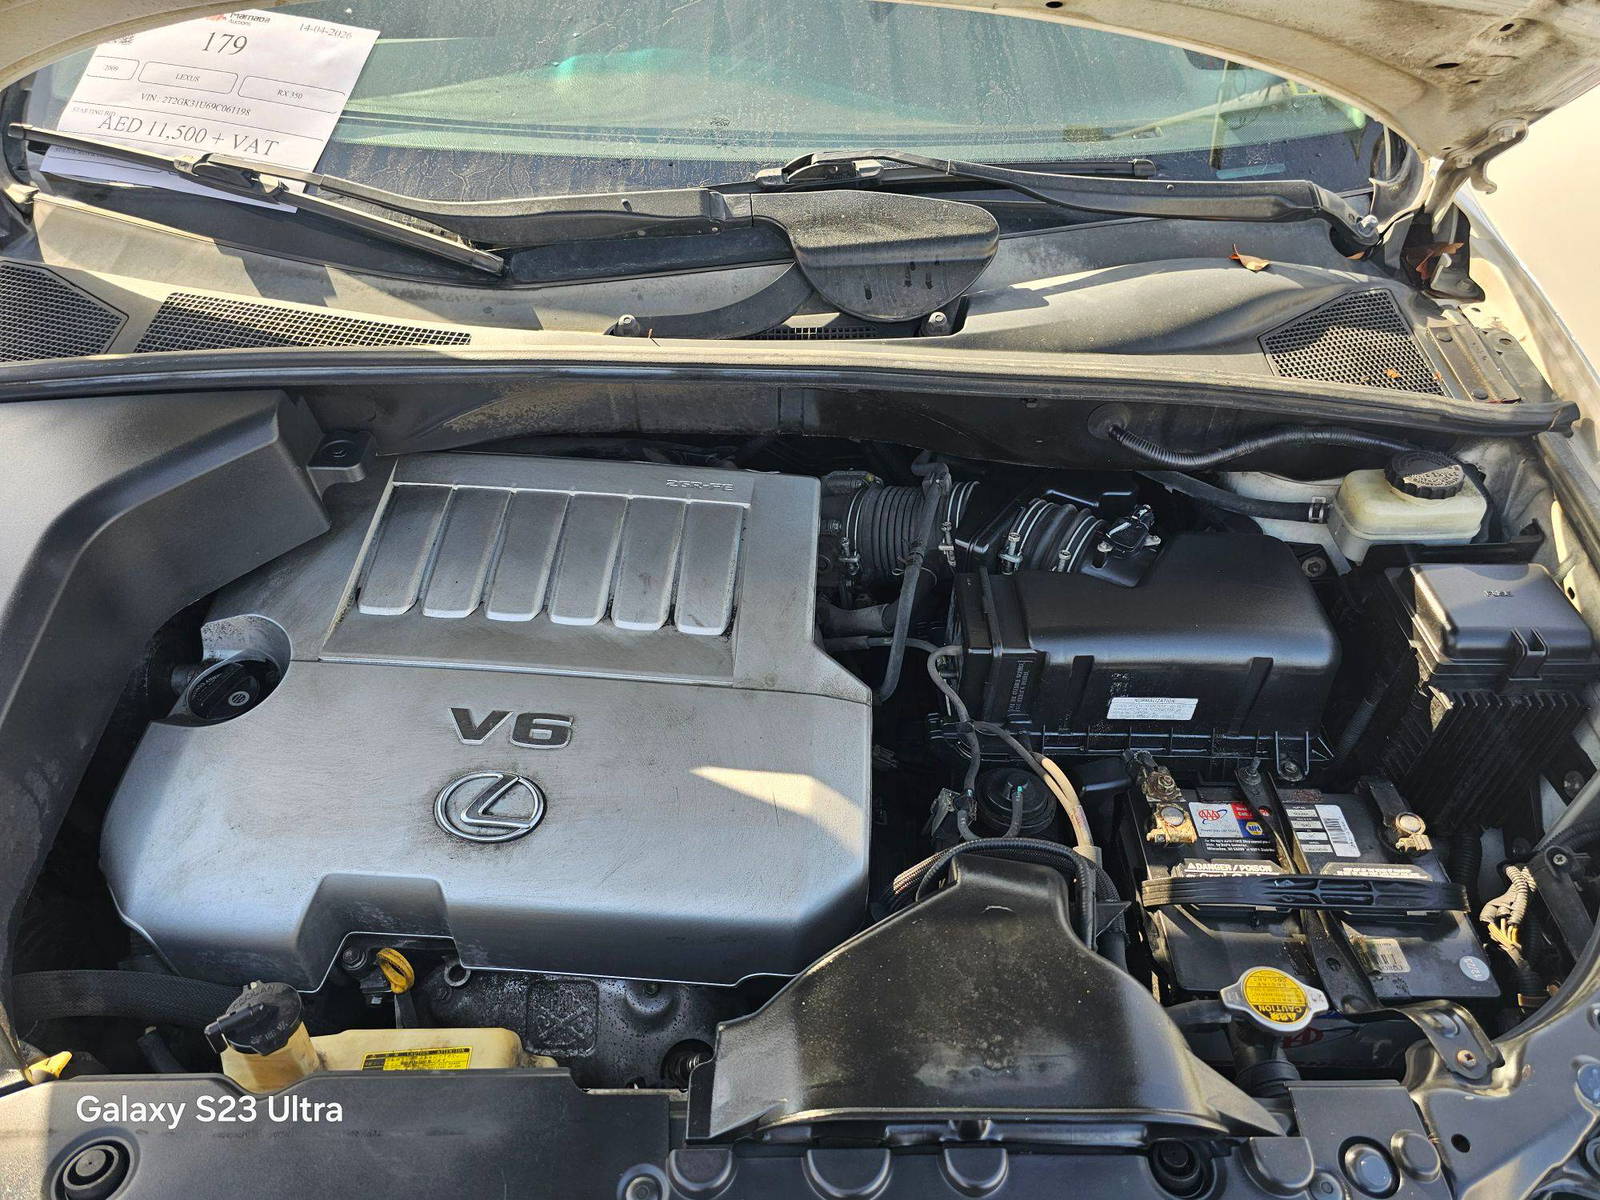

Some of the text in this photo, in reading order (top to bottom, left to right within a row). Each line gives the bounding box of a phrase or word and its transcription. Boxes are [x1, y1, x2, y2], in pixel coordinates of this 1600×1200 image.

[299, 23, 352, 39] 14-04-2026
[202, 32, 248, 55] 179
[175, 73, 201, 82] LEXUS
[141, 92, 157, 102] VIN
[277, 89, 288, 97] RX
[98, 115, 143, 133] AED
[146, 120, 208, 143] 11,500
[233, 134, 280, 156] VAT
[449, 707, 574, 749] V6
[1199, 809, 1221, 820] AAA
[1196, 863, 1233, 871] DANGER
[1240, 864, 1273, 872] POISON
[1258, 1004, 1302, 1013] CAUTION
